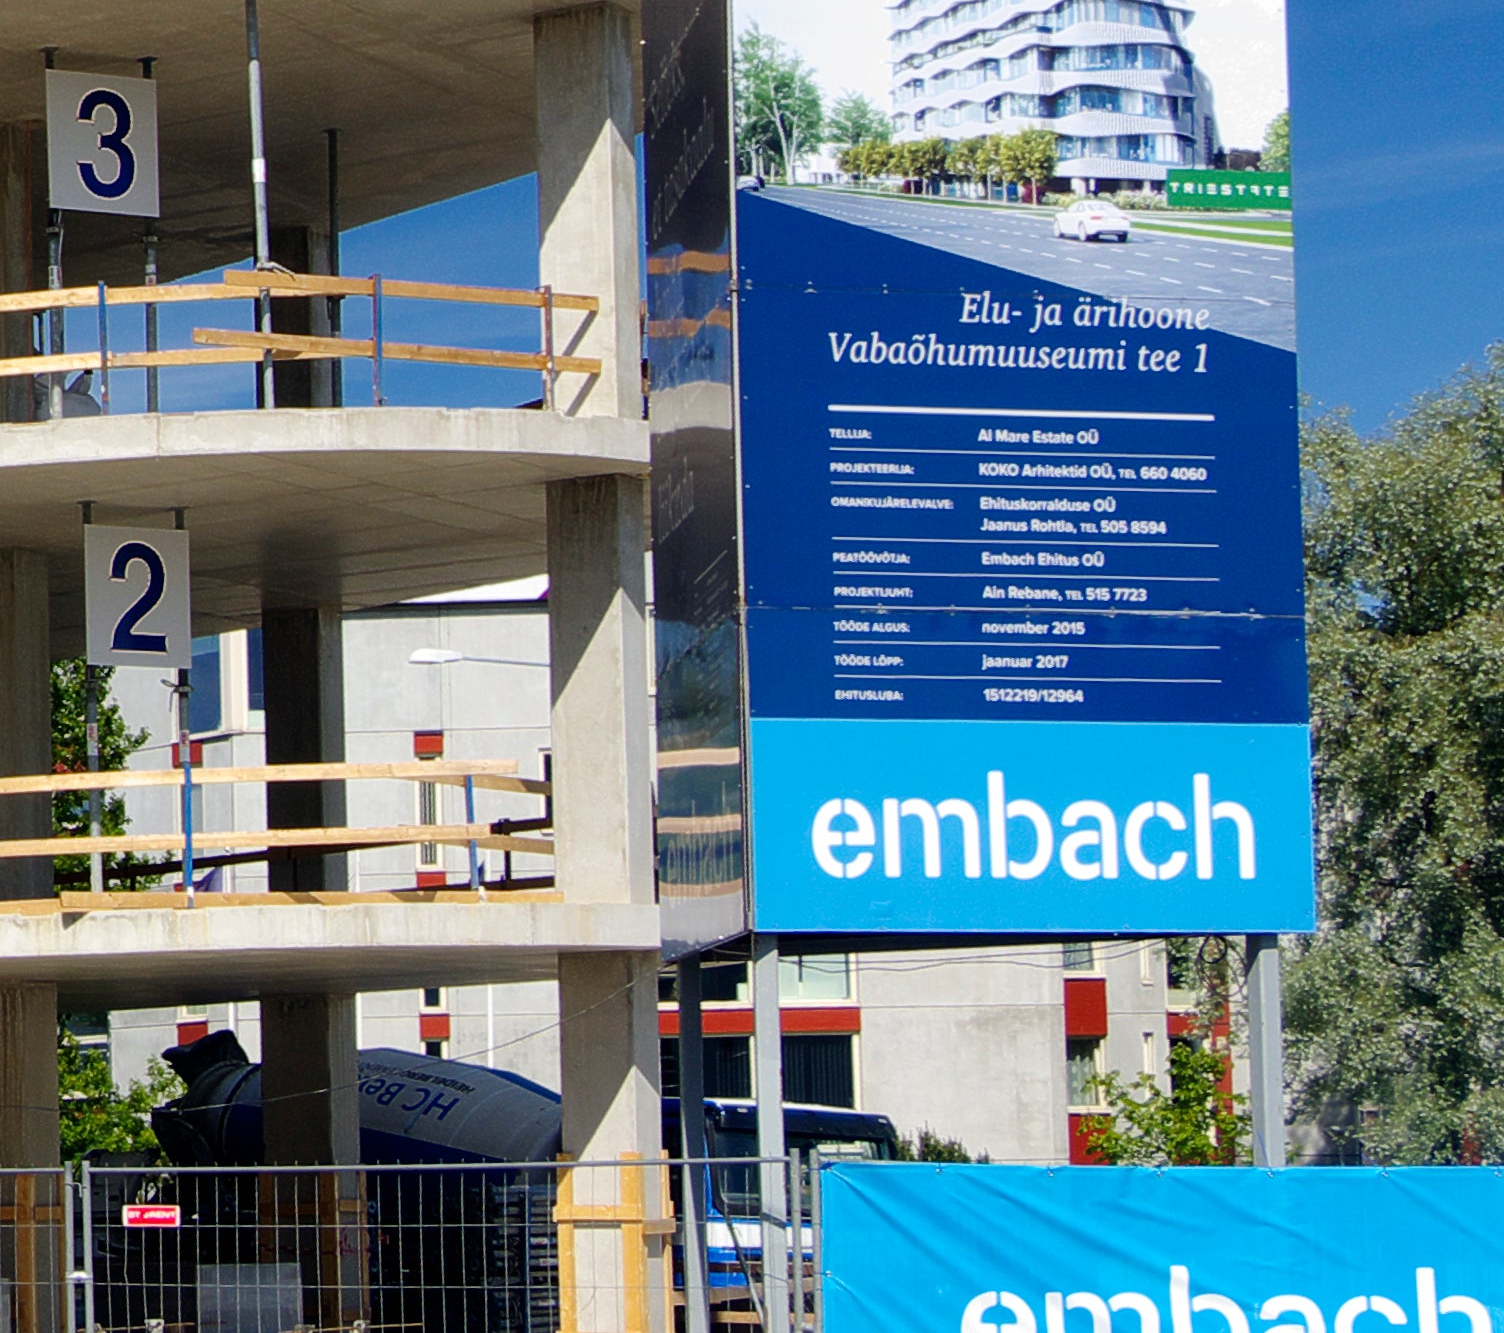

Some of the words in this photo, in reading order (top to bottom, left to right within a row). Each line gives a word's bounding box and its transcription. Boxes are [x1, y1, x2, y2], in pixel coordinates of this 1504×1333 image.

[76, 87, 137, 201] 3
[959, 291, 1023, 325] Elu-
[1028, 296, 1063, 334] ja
[1073, 295, 1210, 330] ärihoone
[828, 331, 1128, 371] Vabaõhumuuseumi
[1137, 345, 1182, 373] tee
[1194, 342, 1209, 373] 1
[995, 429, 1030, 444] Mare
[1032, 430, 1075, 445] Estate
[1076, 428, 1100, 445] OÜ
[978, 463, 1020, 477] KOKO
[1021, 463, 1088, 479] Arhitektid
[1140, 466, 1169, 480] 660
[1170, 467, 1208, 481] 4060
[979, 496, 1091, 511] Ehituskorralduse
[1092, 496, 1117, 512] OÜ
[980, 518, 1029, 532] Jaanus
[1100, 520, 1129, 533] 505
[1130, 520, 1167, 534] 8594
[981, 552, 1035, 566] Embach
[1037, 552, 1080, 567] Ehitus
[1081, 550, 1105, 567] OÜ
[109, 540, 168, 654] 2
[982, 585, 1006, 599] Ain
[1008, 586, 1063, 601] Rebane,
[1085, 587, 1111, 601] 515
[1112, 588, 1148, 602] 7723
[981, 620, 1050, 634] november
[1051, 621, 1086, 635] 2015
[981, 654, 1033, 670] jaanuar
[1035, 655, 1069, 669] 2017
[983, 688, 1085, 703] 1512219/12964
[811, 770, 1256, 880] embach
[400, 1087, 460, 1121] HC
